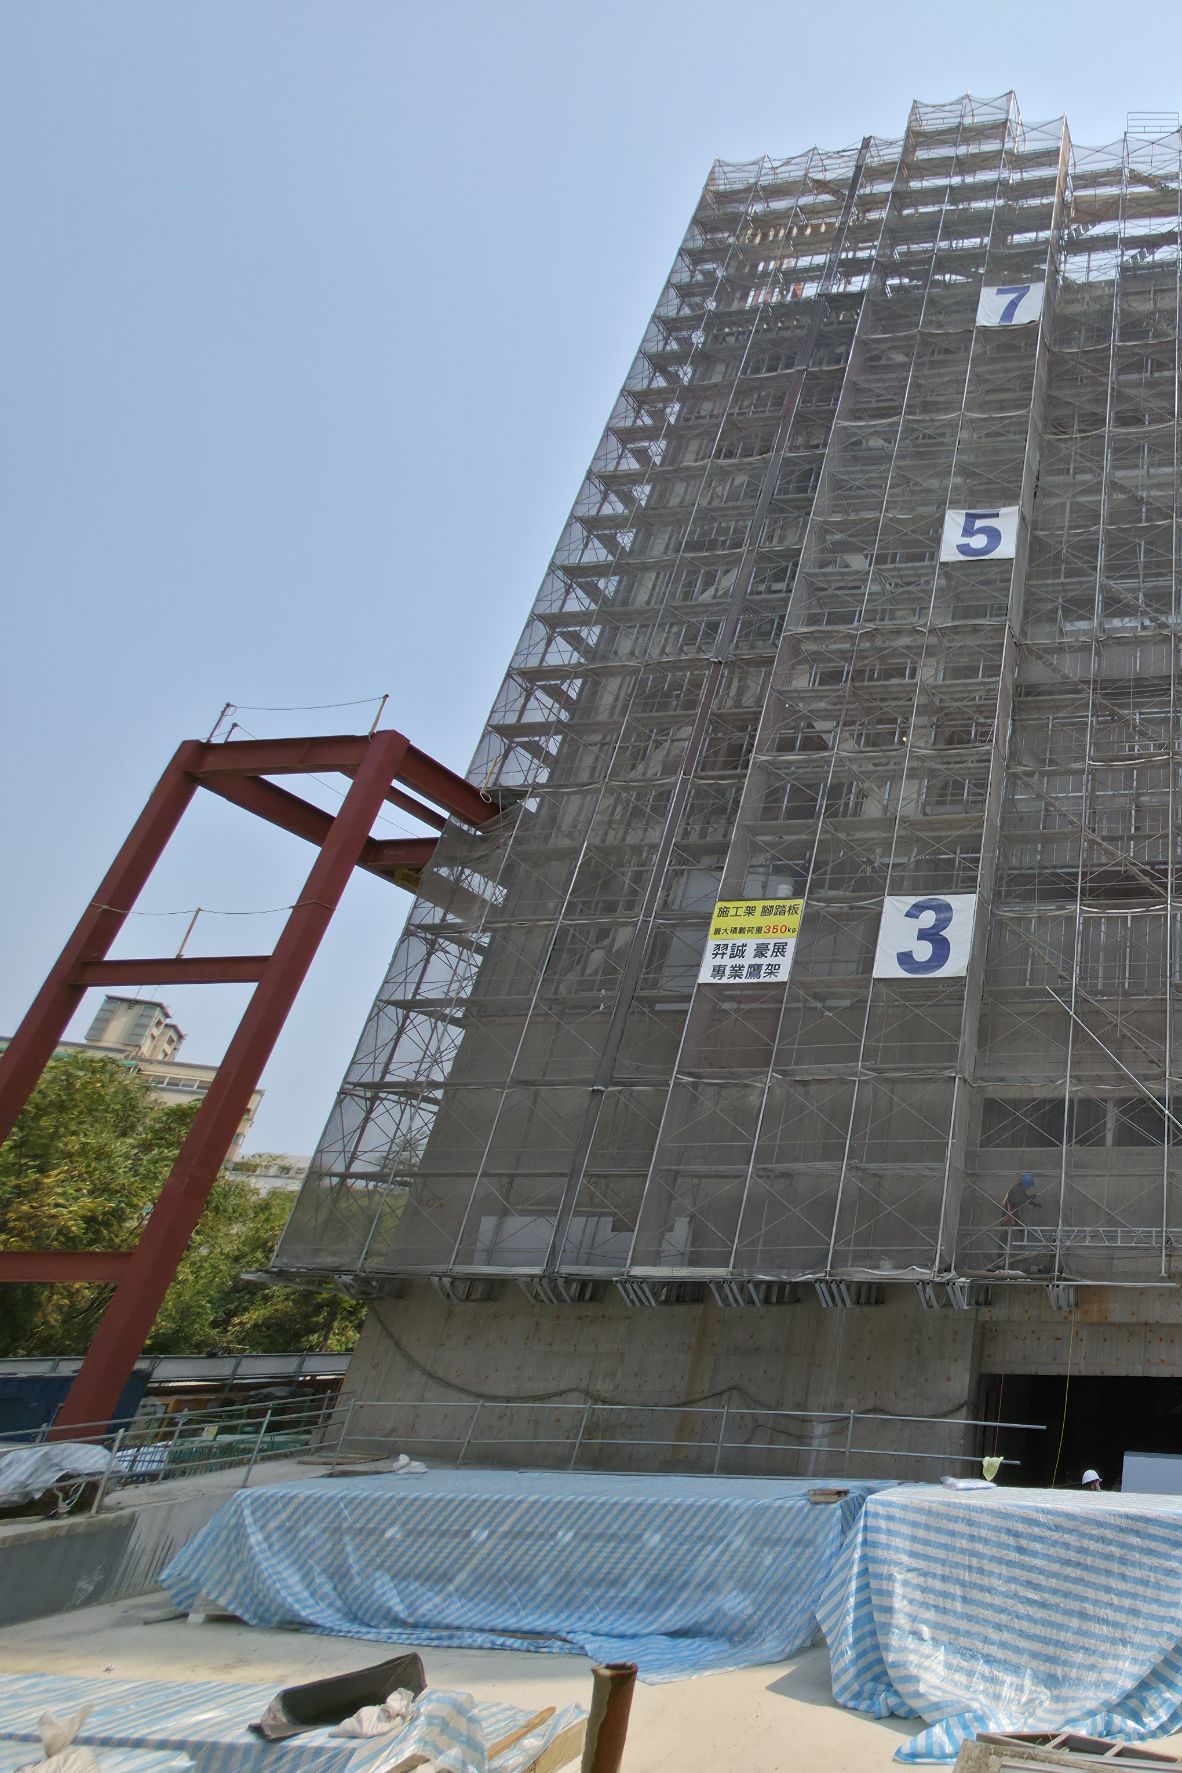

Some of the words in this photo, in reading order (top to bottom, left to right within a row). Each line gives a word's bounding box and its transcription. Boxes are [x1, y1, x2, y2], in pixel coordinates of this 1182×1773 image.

[996, 285, 1030, 324] 7
[956, 511, 1002, 557] 5
[717, 905, 757, 918] 施工架
[760, 904, 801, 917] 腳踏板
[752, 942, 788, 959] 豪展
[896, 898, 953, 975] 3
[710, 962, 781, 981] 專業鷹架
